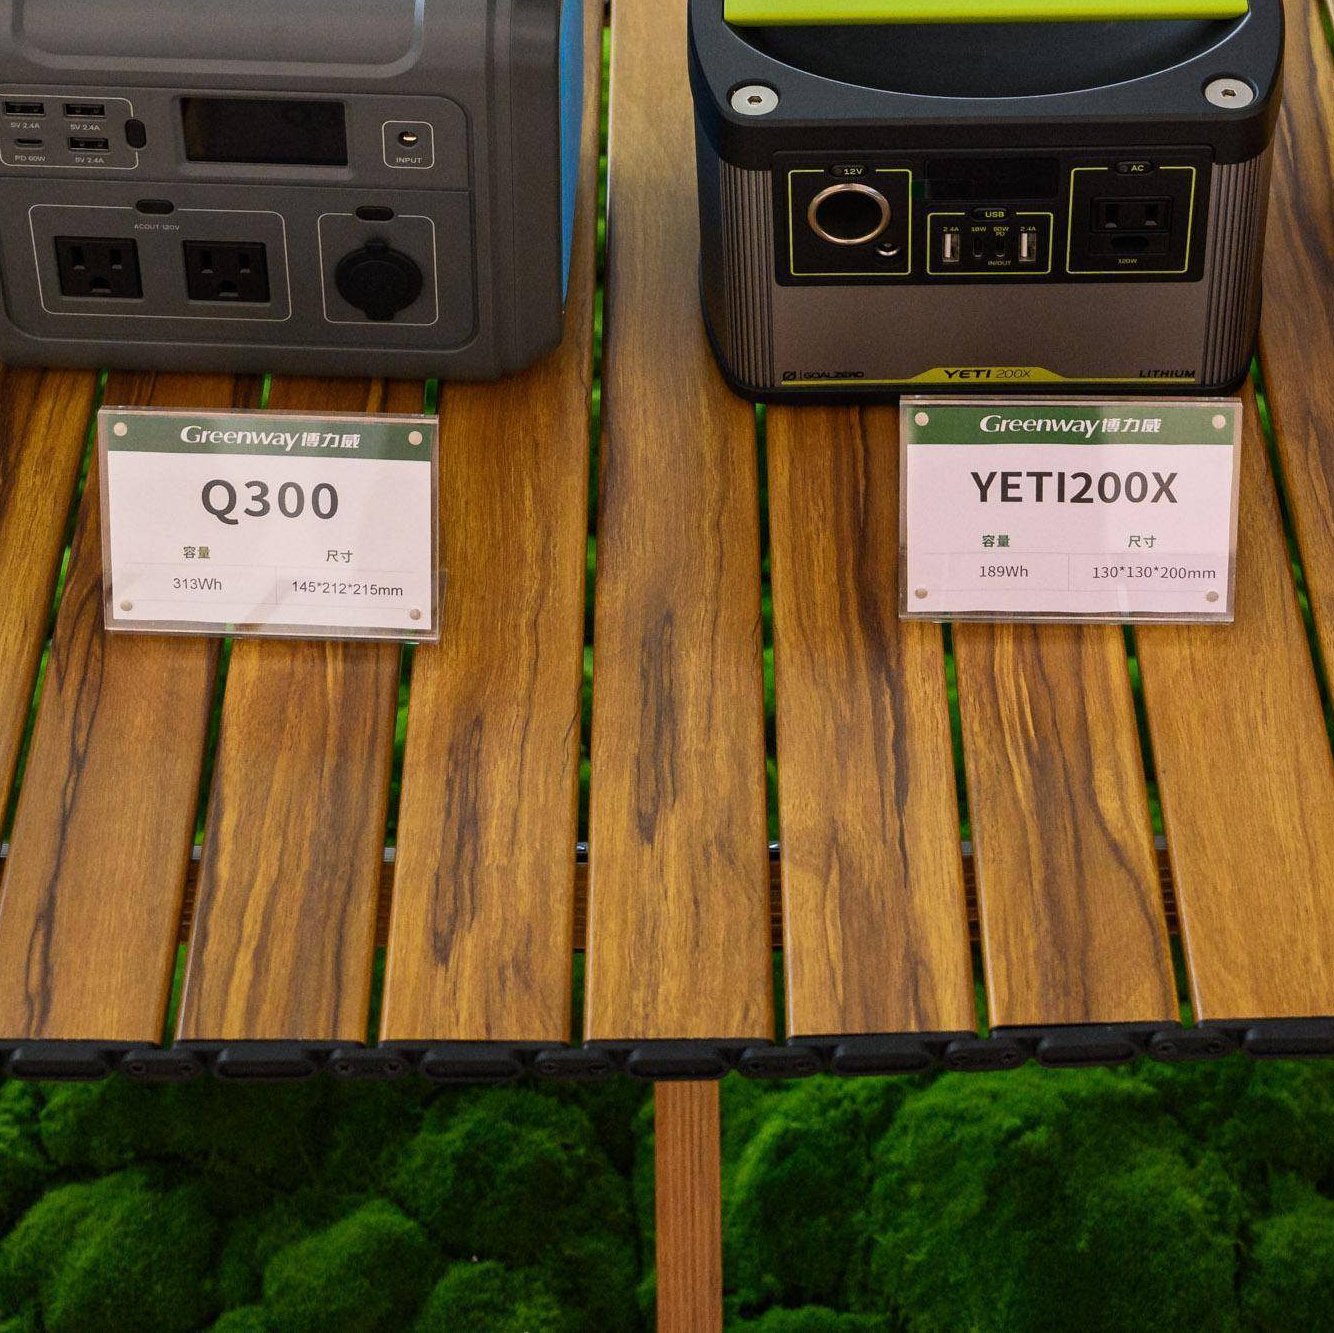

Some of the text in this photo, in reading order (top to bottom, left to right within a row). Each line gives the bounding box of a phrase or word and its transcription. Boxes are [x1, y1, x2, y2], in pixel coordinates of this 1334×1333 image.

[396, 156, 423, 164] INPUT
[944, 369, 1032, 379] YETI 200X
[1139, 369, 1196, 379] LITHIUM
[979, 414, 1101, 438] Greenway
[1101, 417, 1162, 433] 博力威
[180, 425, 300, 451] Greenway
[301, 431, 361, 449] 博力威
[970, 470, 1178, 504] YETI200X
[201, 478, 339, 526] Q300
[981, 534, 1011, 549] 容量
[1127, 535, 1157, 549] 尺寸
[183, 545, 211, 560] 容量
[326, 549, 354, 564] 尺寸
[979, 565, 1029, 578] 189Wh
[173, 577, 223, 591] 313Wh
